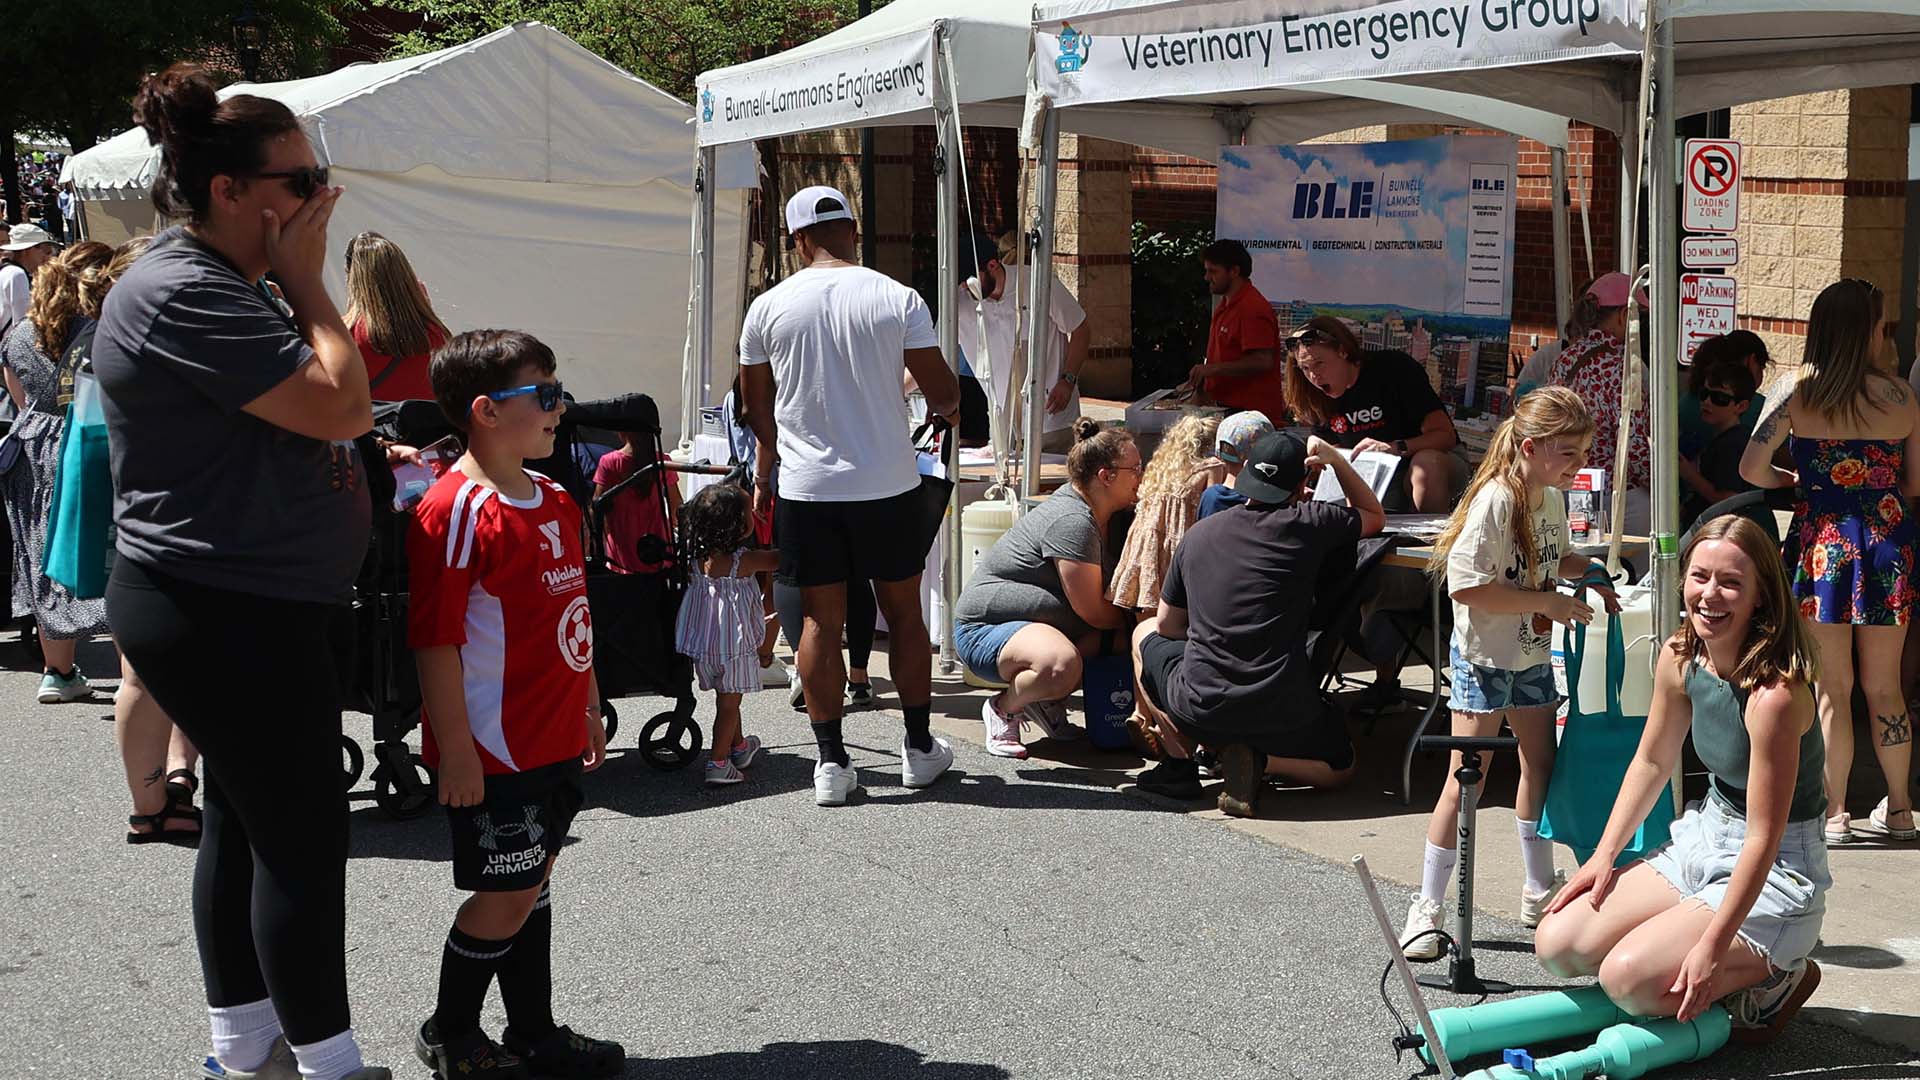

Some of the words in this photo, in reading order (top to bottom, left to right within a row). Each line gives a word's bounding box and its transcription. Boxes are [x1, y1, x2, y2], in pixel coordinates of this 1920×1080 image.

[1120, 27, 1274, 71] Veterinary
[1281, 5, 1469, 60] Emergency
[1481, 0, 1600, 36] Group
[725, 82, 833, 122] Bunnell-Lammons
[837, 59, 925, 108] Engineering
[1389, 178, 1422, 191] BUNNELL
[1472, 178, 1505, 191] BLE
[1292, 181, 1375, 219] BLE
[1386, 195, 1420, 206] LAMMONS
[1693, 198, 1730, 208] LOADING
[1699, 207, 1723, 217] ZONE
[1235, 239, 1302, 250] NVIRONMENTAL
[1312, 239, 1367, 250] GEOTECHNICAL
[1374, 240, 1416, 250] CONSTRUCTION
[1417, 240, 1443, 250] MATERIALS
[1686, 248, 1697, 257] 30
[1698, 247, 1713, 257] MIN
[1714, 247, 1735, 257] LIMIT
[1682, 281, 1697, 299] NO
[1699, 286, 1734, 298] PARKING
[1696, 308, 1719, 318] WED
[1685, 318, 1704, 328] 4-7
[488, 844, 542, 864] UNDER
[482, 849, 547, 875] ARMOUR
[1457, 841, 1469, 918] Blackburn
